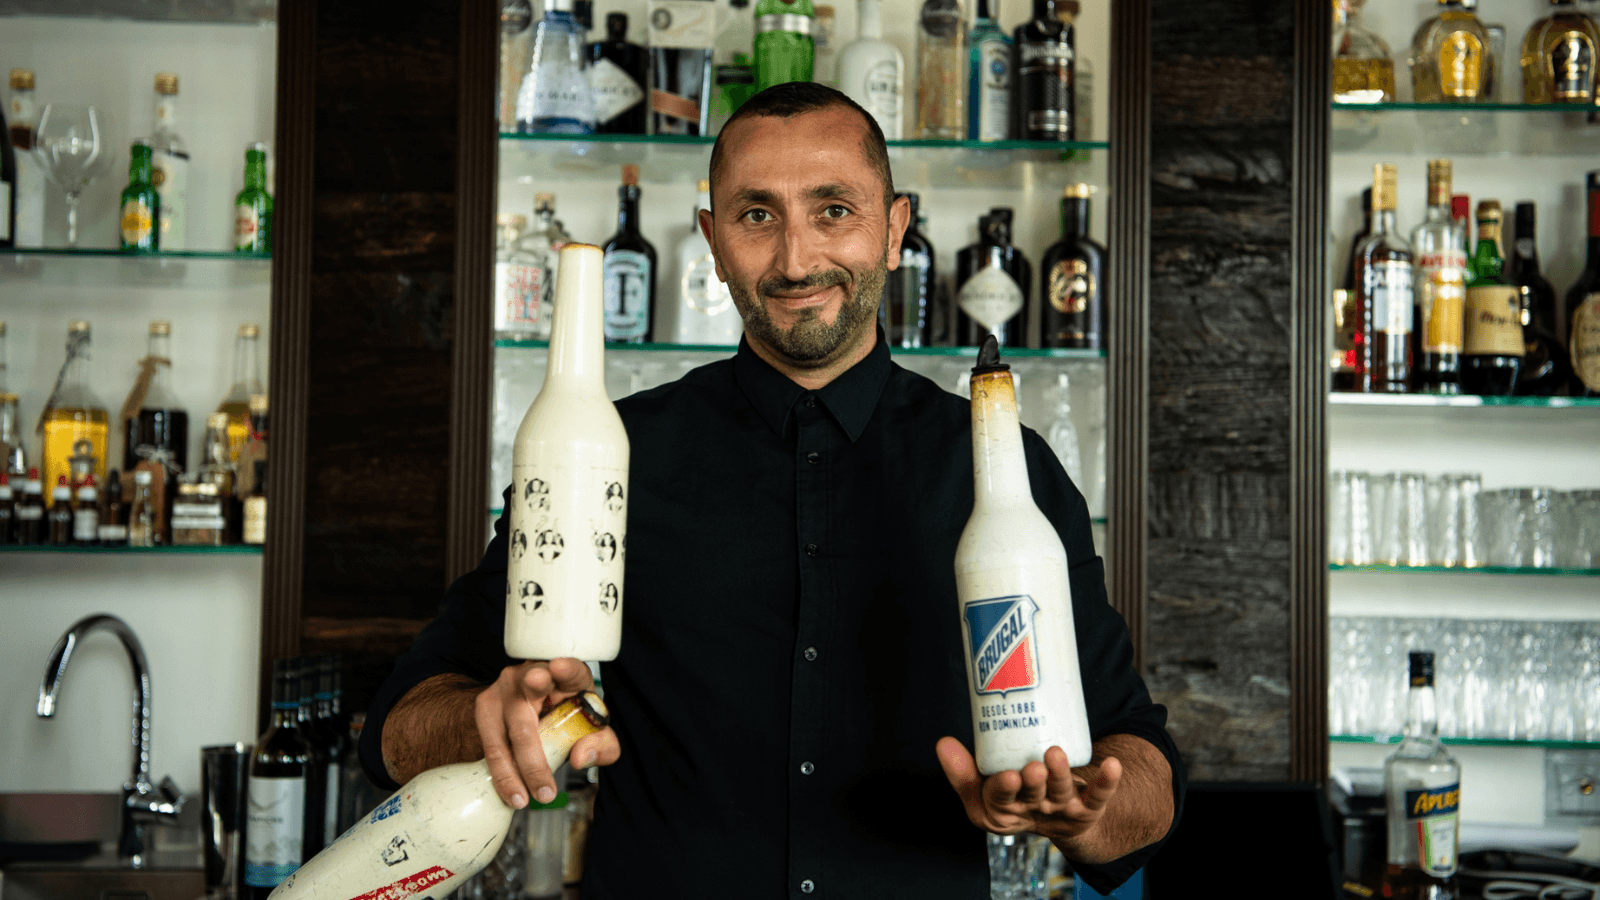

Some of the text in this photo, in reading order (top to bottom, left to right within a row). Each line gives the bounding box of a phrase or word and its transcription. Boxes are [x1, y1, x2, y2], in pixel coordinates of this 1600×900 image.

[977, 605, 1026, 687] BRUGAL
[981, 702, 1036, 717] DESDE 1888
[993, 716, 1047, 731] DOMINICANO
